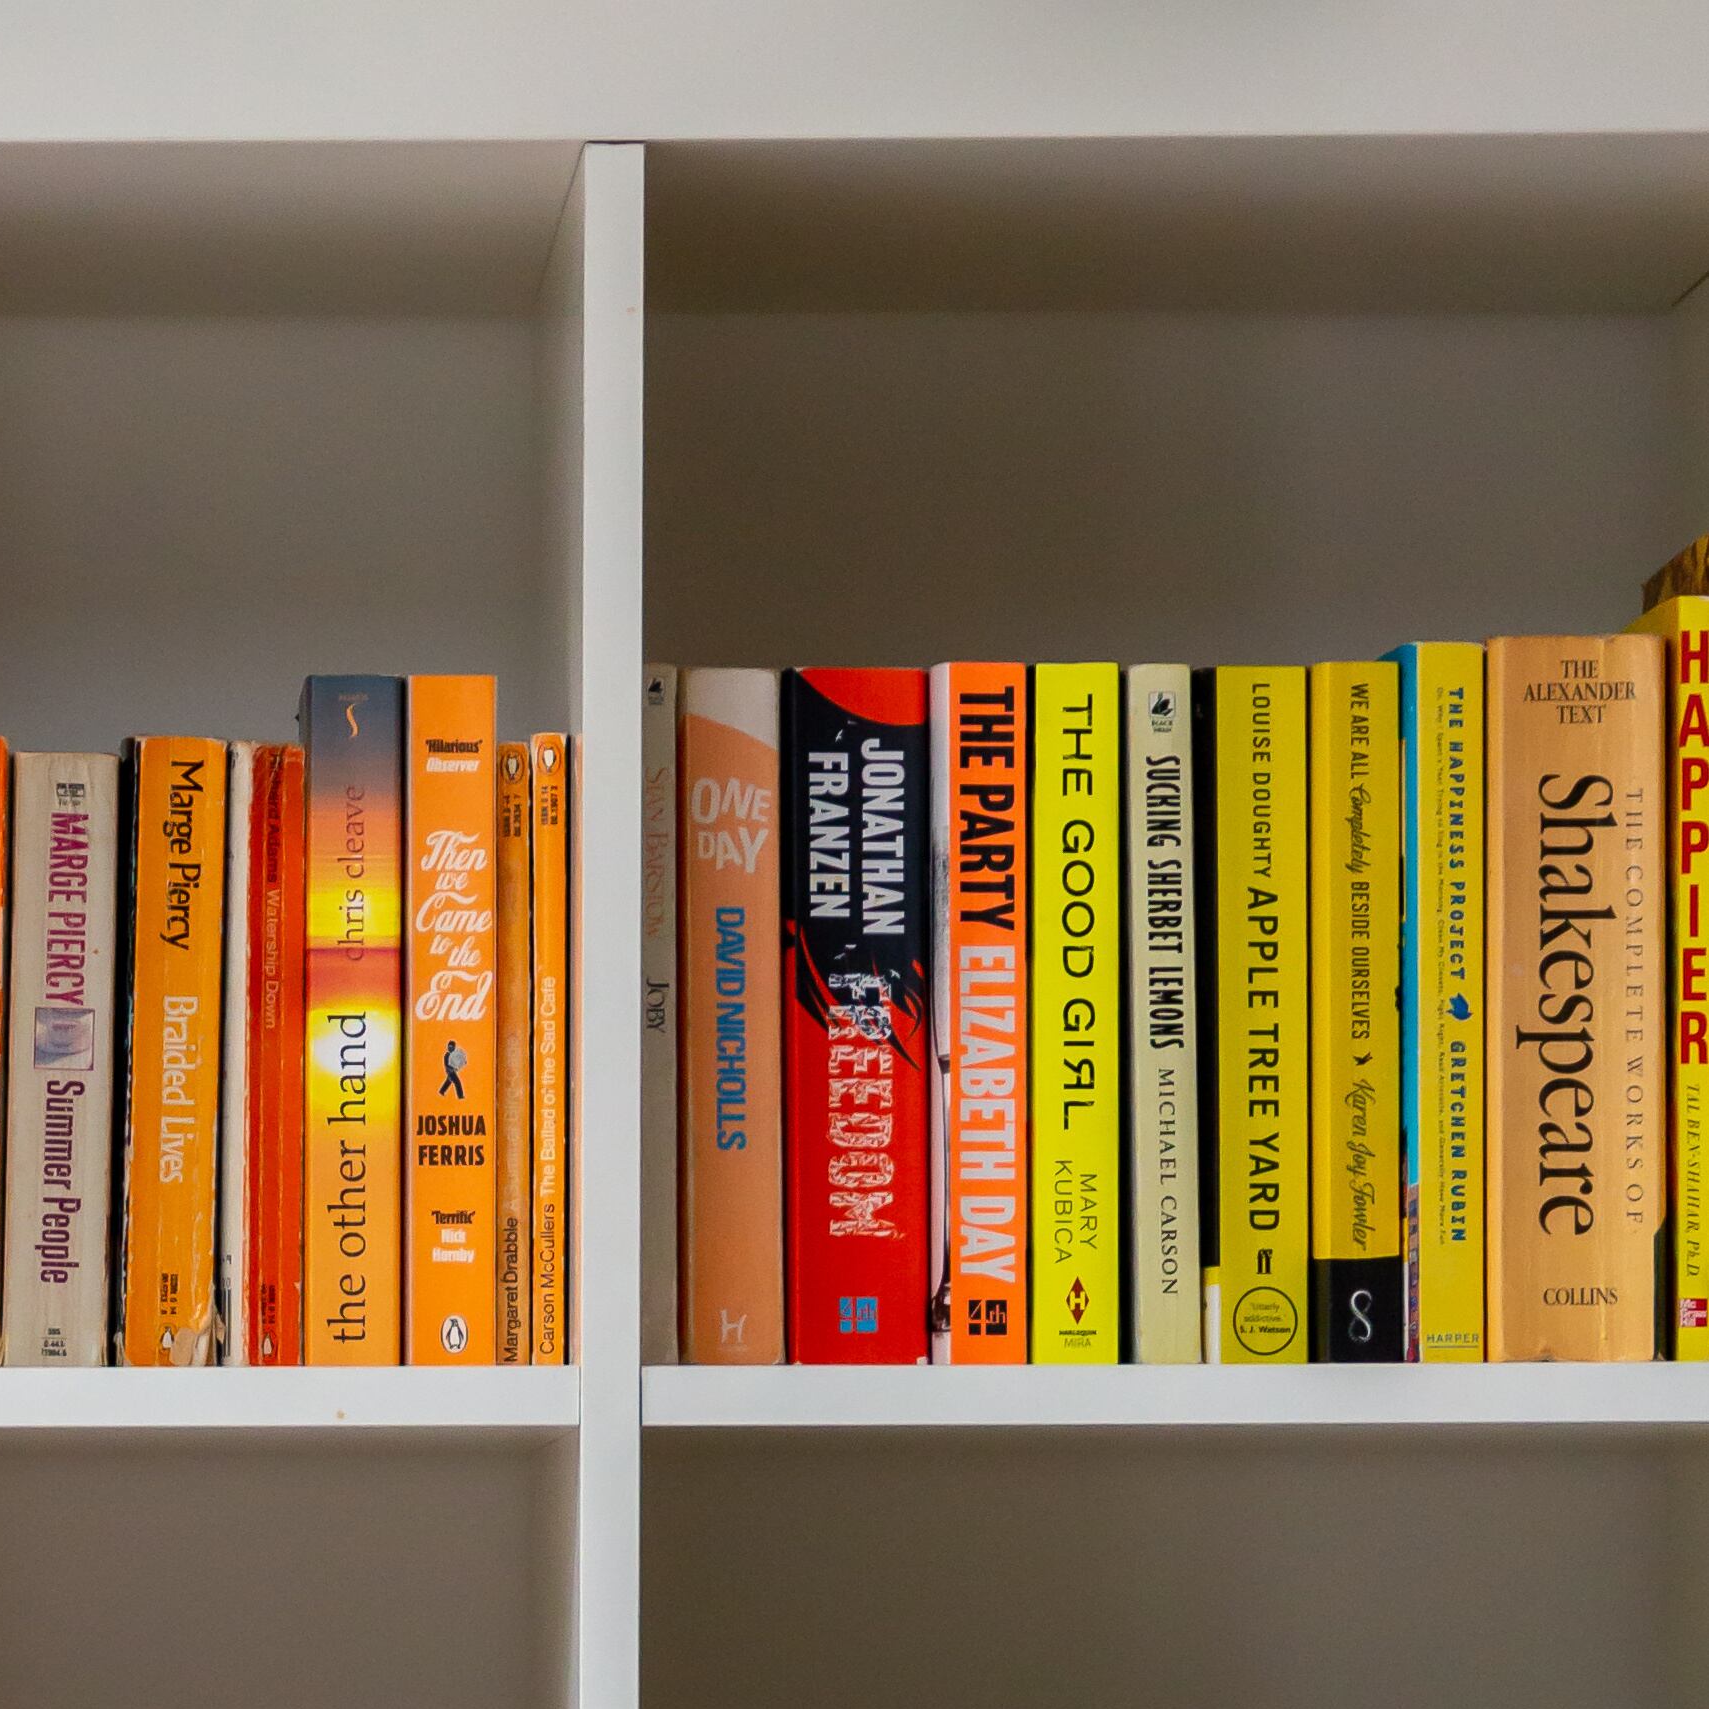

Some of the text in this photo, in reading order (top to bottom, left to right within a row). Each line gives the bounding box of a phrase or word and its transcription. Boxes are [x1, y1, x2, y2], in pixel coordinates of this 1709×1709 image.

[39, 813, 88, 1284] MARGE PIERCY Summer People
[417, 1114, 487, 1136] JOSHUA
[417, 1145, 486, 1166] FERRIS
[1146, 756, 1184, 1295] SUCKING SHERBET LEMONS MICHAEL CARSON
[1448, 687, 1467, 1243] THE HAPPINESS PROJECT GRETCHEN RUBIN
[1516, 773, 1618, 1237] Shakespeare
[1543, 1288, 1618, 1305] COLLINS
